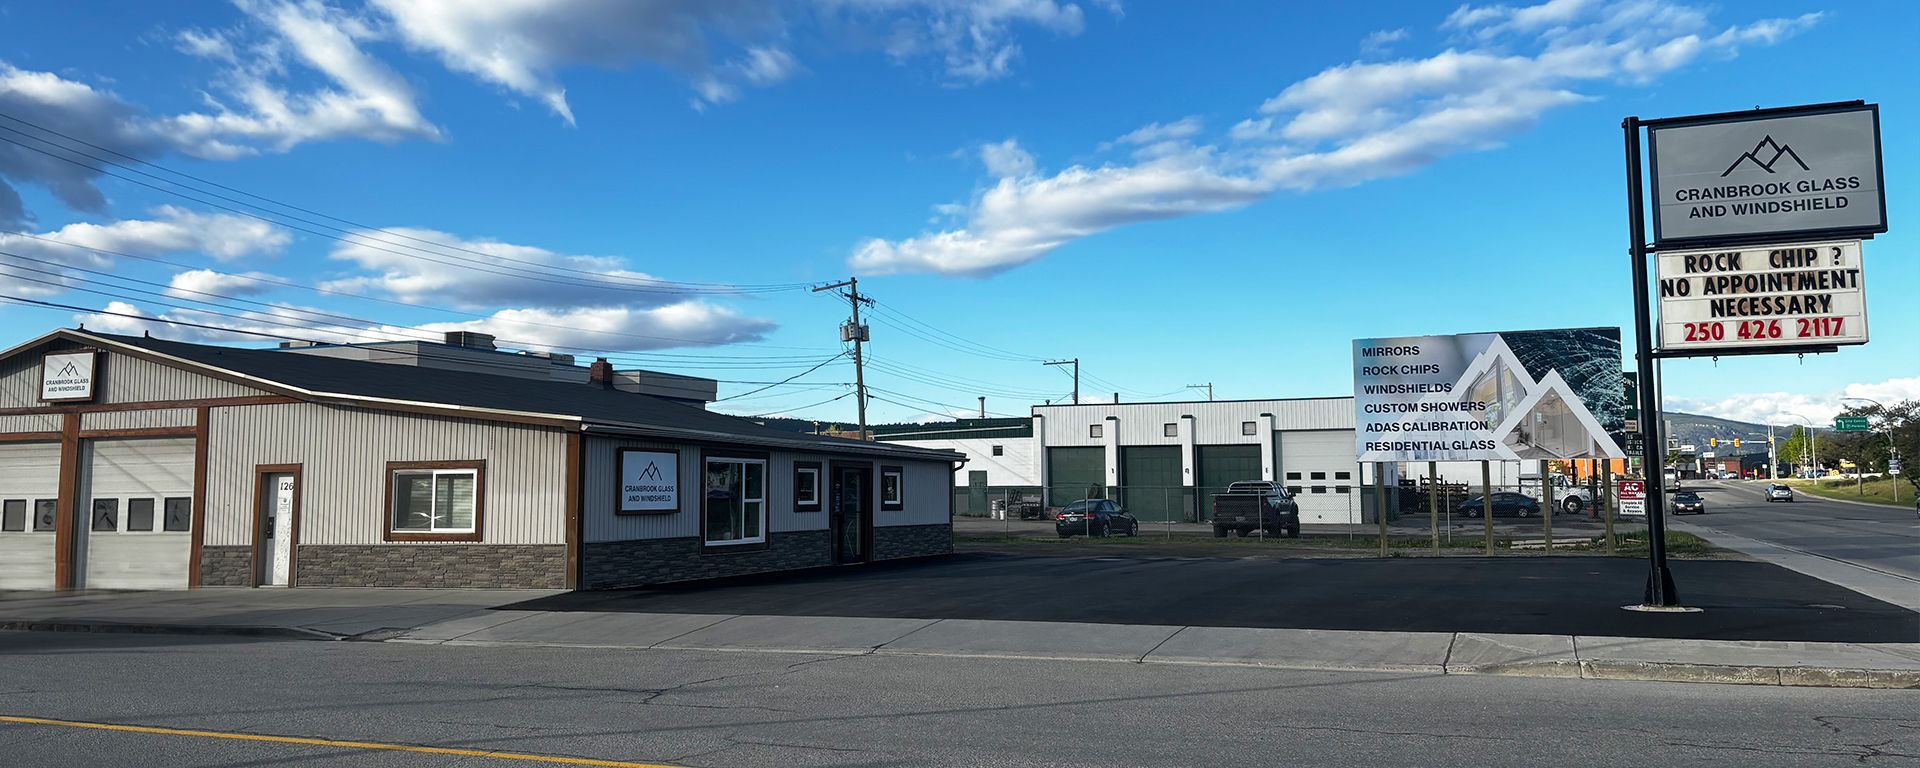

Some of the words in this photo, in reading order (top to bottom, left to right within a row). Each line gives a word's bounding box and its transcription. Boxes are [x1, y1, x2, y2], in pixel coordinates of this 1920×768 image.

[1675, 182, 1792, 202] CRANBROOK
[1796, 176, 1861, 193] GLASS
[1688, 204, 1727, 220] AND
[1731, 196, 1849, 216] WINDSHIELD
[1685, 252, 1741, 274] ROCK
[1769, 248, 1818, 269] CHIP
[1831, 246, 1842, 266] ?
[1660, 278, 1690, 298] NO
[1703, 269, 1860, 296] APPOINTMENT
[1710, 294, 1832, 318] NECESSARY
[1684, 322, 1725, 342] 250
[1737, 319, 1782, 340] 426
[1797, 317, 1844, 338] 2117
[1362, 346, 1420, 357] MIRRORS
[1362, 364, 1398, 376] ROCK
[1401, 363, 1440, 375] CHIPS
[1364, 382, 1452, 395] WINDSHIELDS
[1364, 402, 1419, 413] CUSTOM
[1421, 401, 1486, 412] SHOWERS
[1365, 422, 1400, 433] ADAS
[1402, 420, 1489, 432] CALIBRATION
[1365, 440, 1449, 452] RESIDENTIAL
[1452, 440, 1496, 450] GLASS
[281, 482, 294, 490] 126
[1624, 482, 1639, 491] AC
